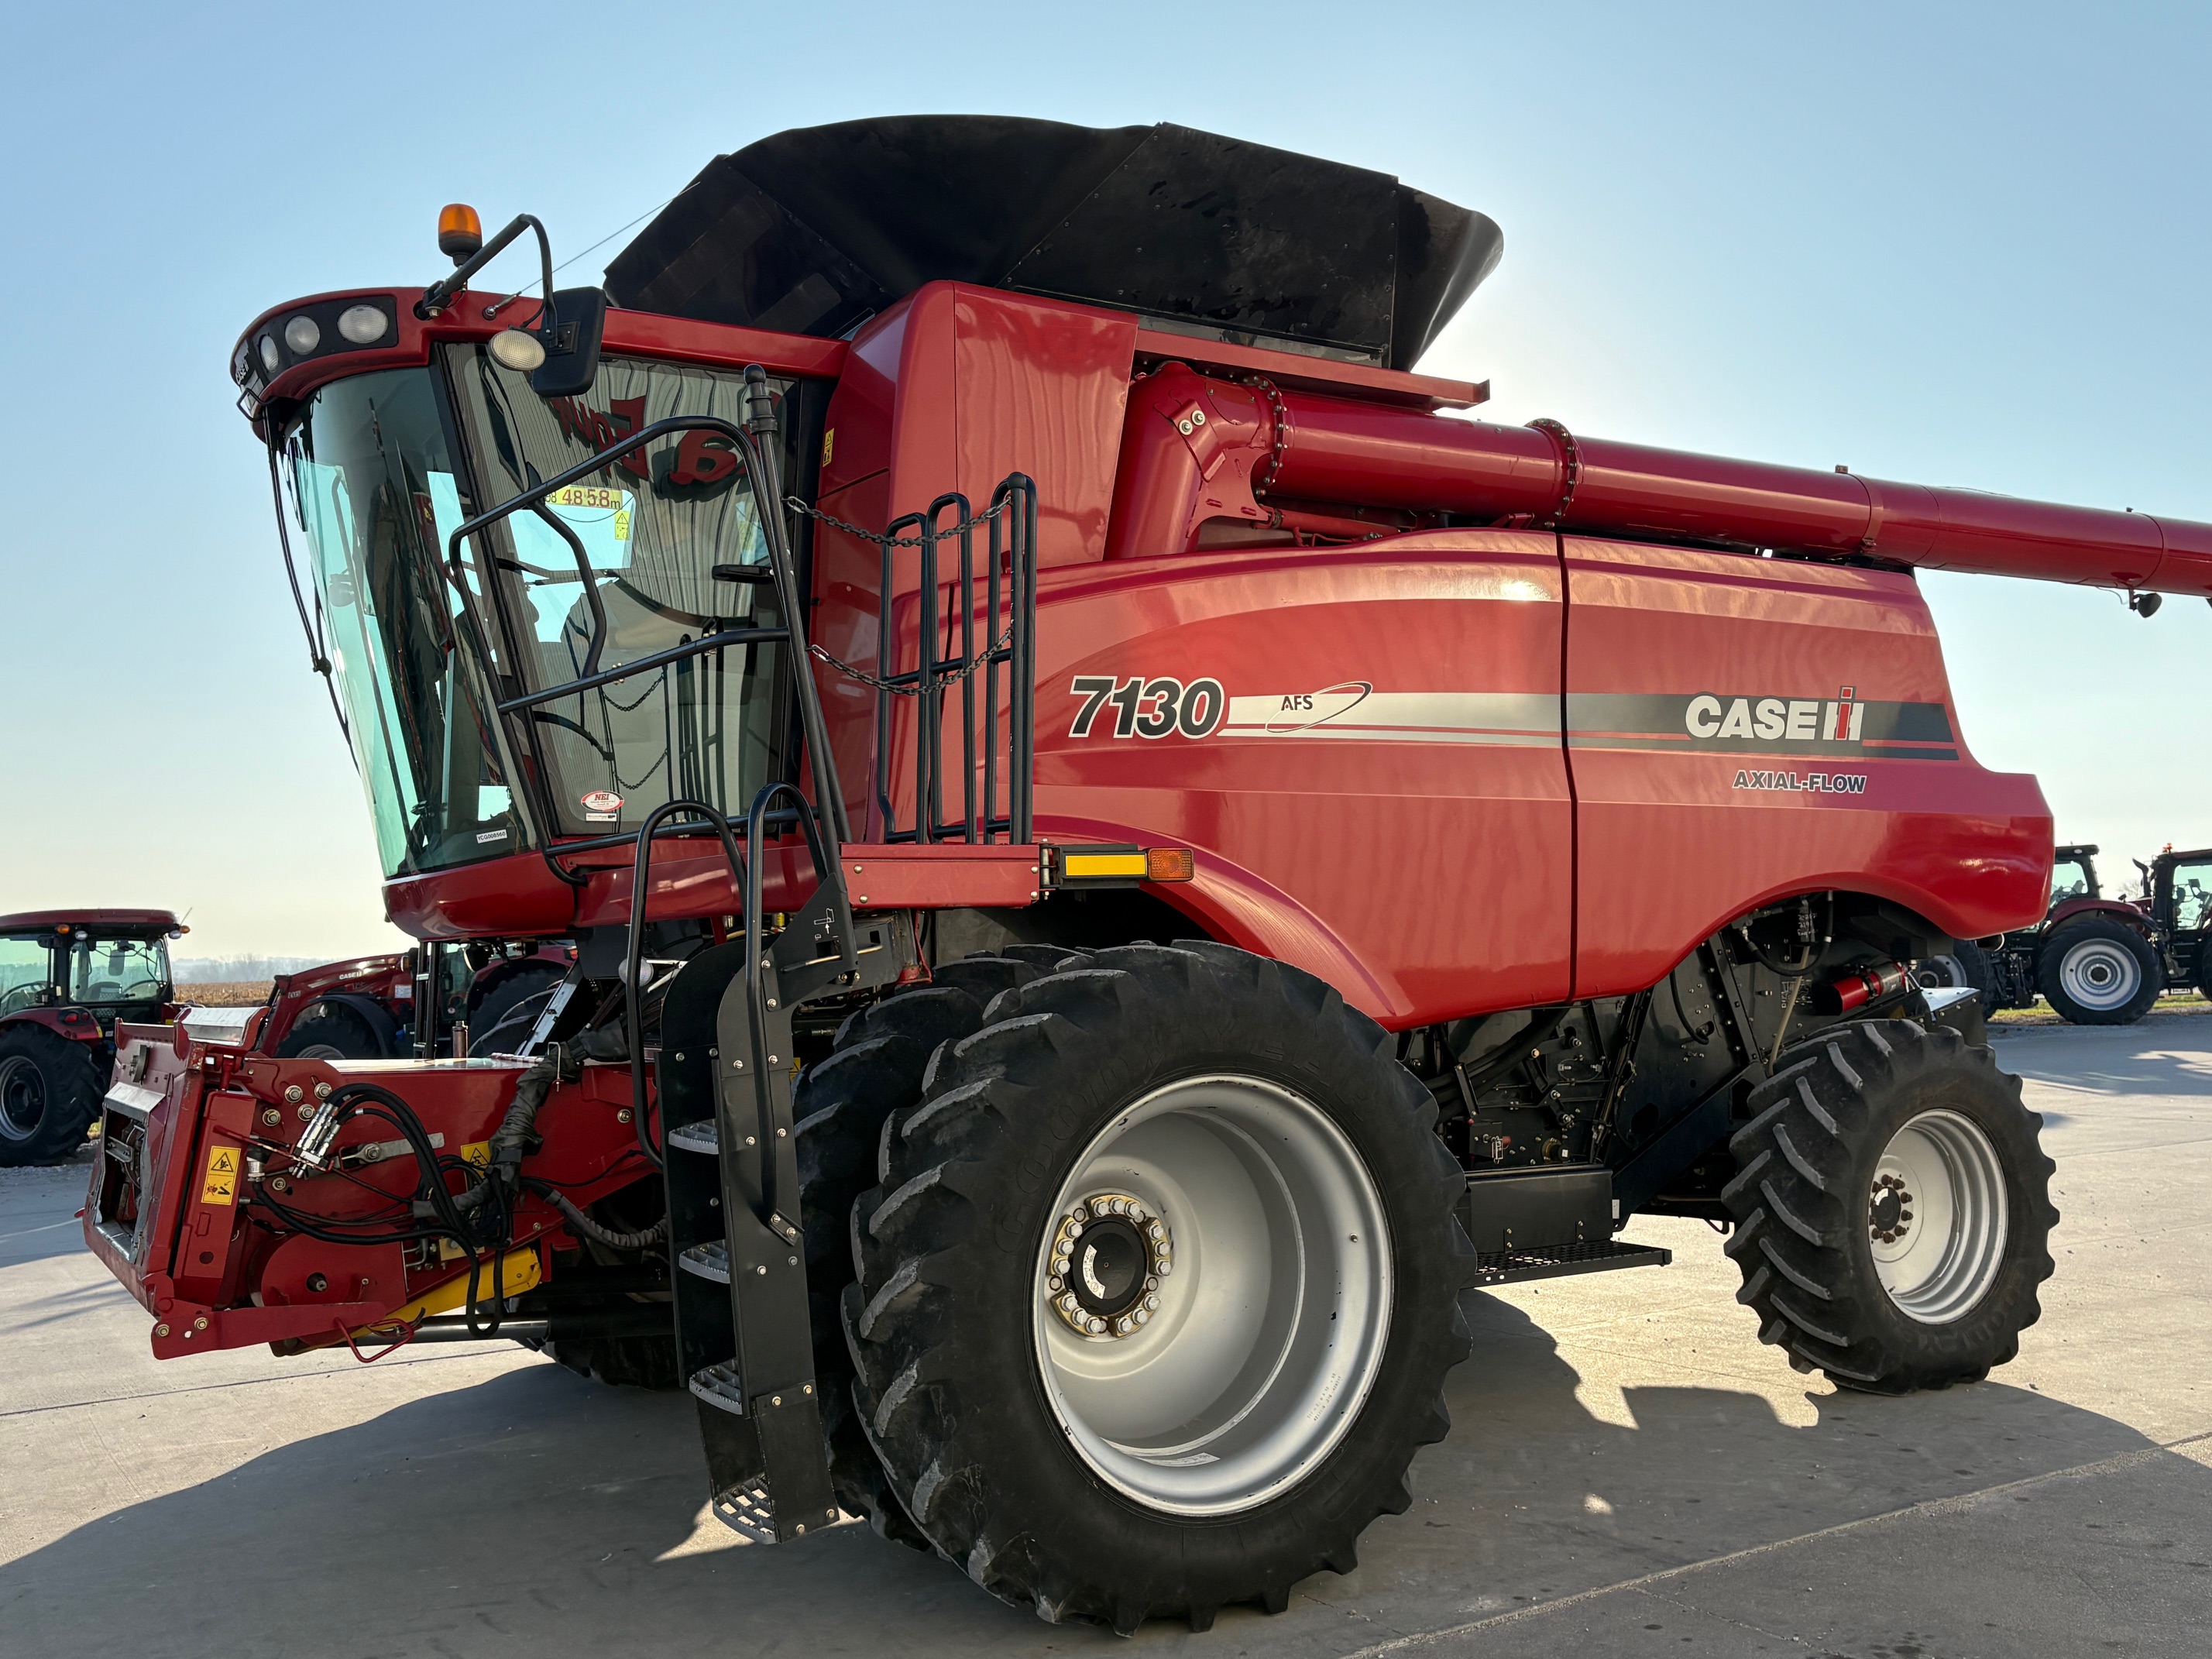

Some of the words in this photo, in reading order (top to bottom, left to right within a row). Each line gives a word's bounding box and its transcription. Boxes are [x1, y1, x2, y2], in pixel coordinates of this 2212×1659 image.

[1068, 675, 1224, 740] 7130
[1281, 696, 1313, 711] AFS
[1685, 695, 1819, 740] CASE
[1732, 770, 1867, 794] AXIAL-FLOW
